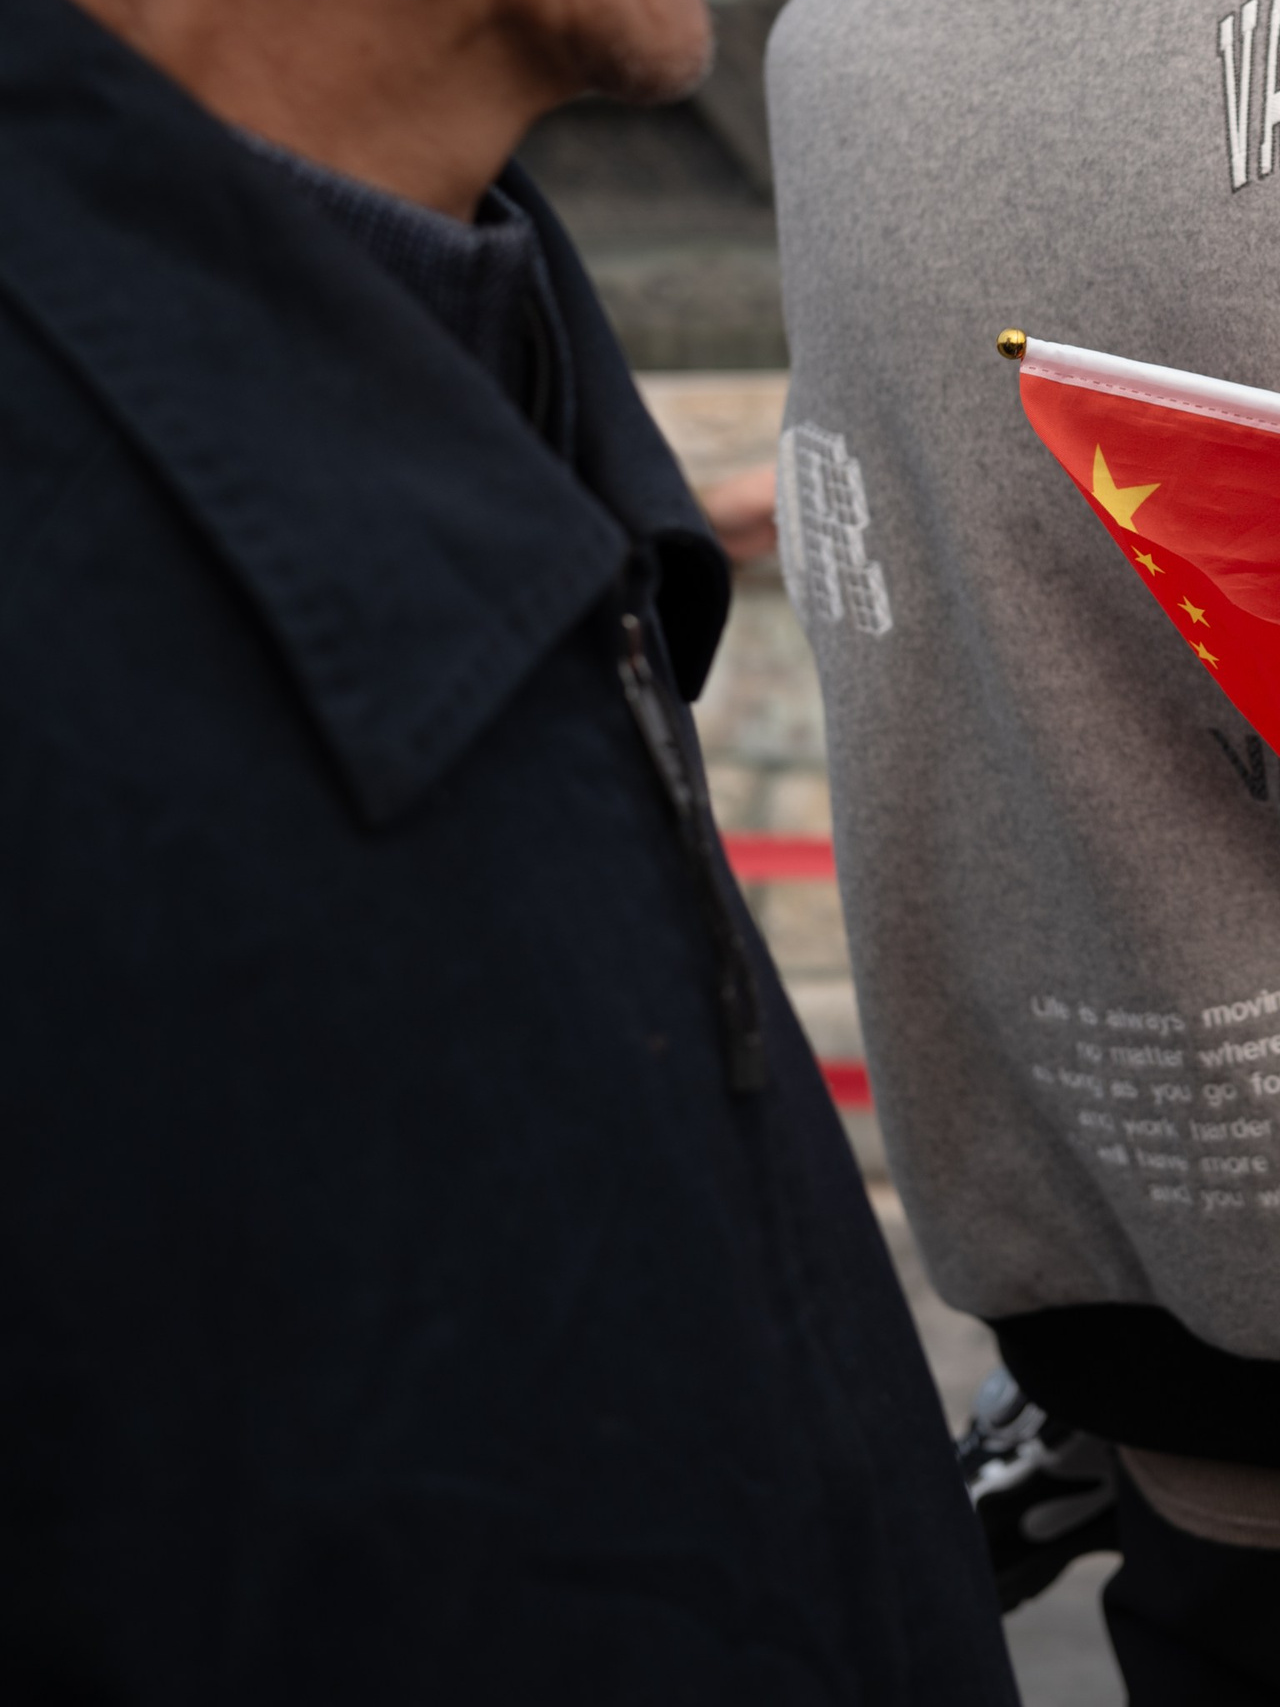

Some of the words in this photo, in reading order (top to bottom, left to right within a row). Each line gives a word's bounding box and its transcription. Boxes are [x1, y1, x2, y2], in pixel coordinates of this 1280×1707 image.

[1105, 1006, 1186, 1036] always
[1109, 1045, 1183, 1068] matter
[1151, 1082, 1193, 1106] you
[1202, 1081, 1238, 1108] go
[1190, 1117, 1273, 1142] harder
[1202, 1154, 1269, 1175] more
[1201, 1187, 1246, 1213] you
